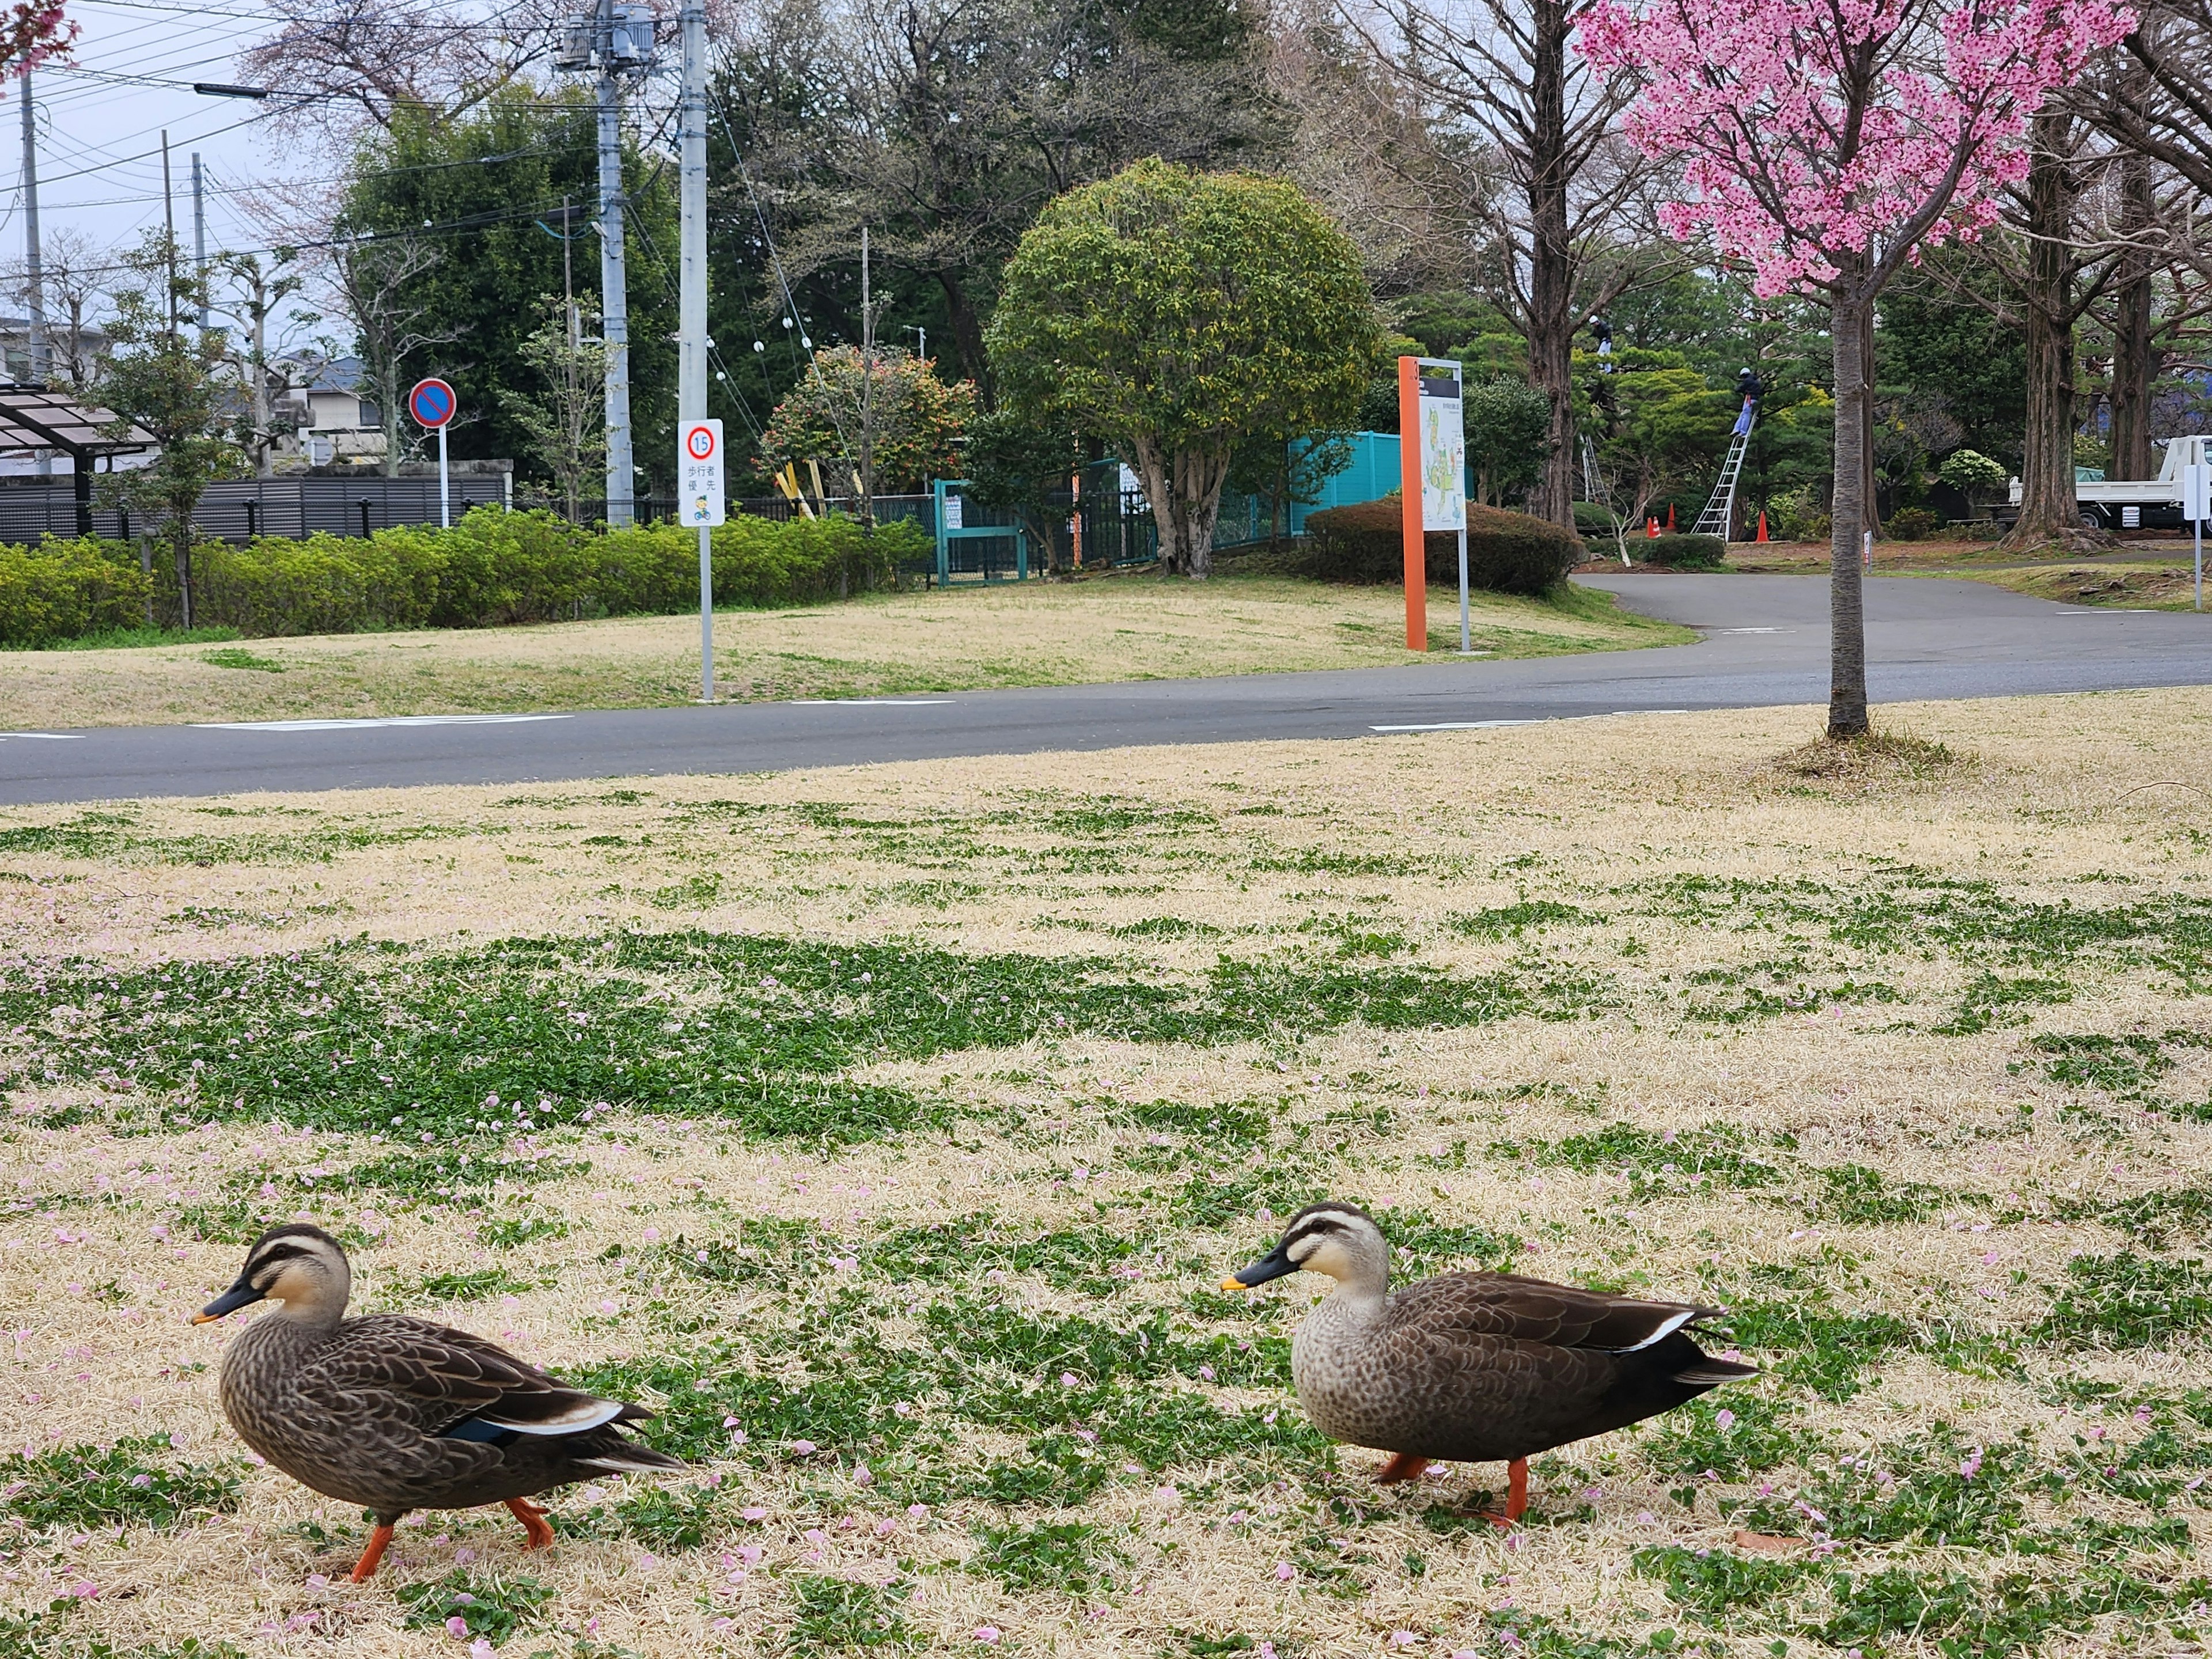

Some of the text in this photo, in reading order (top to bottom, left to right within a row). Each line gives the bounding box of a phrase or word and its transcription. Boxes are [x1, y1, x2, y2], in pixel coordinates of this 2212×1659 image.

[1414, 361, 1418, 380] 3
[694, 437, 708, 451] 15
[688, 466, 715, 477] 歩行者
[688, 480, 715, 491] 優先
